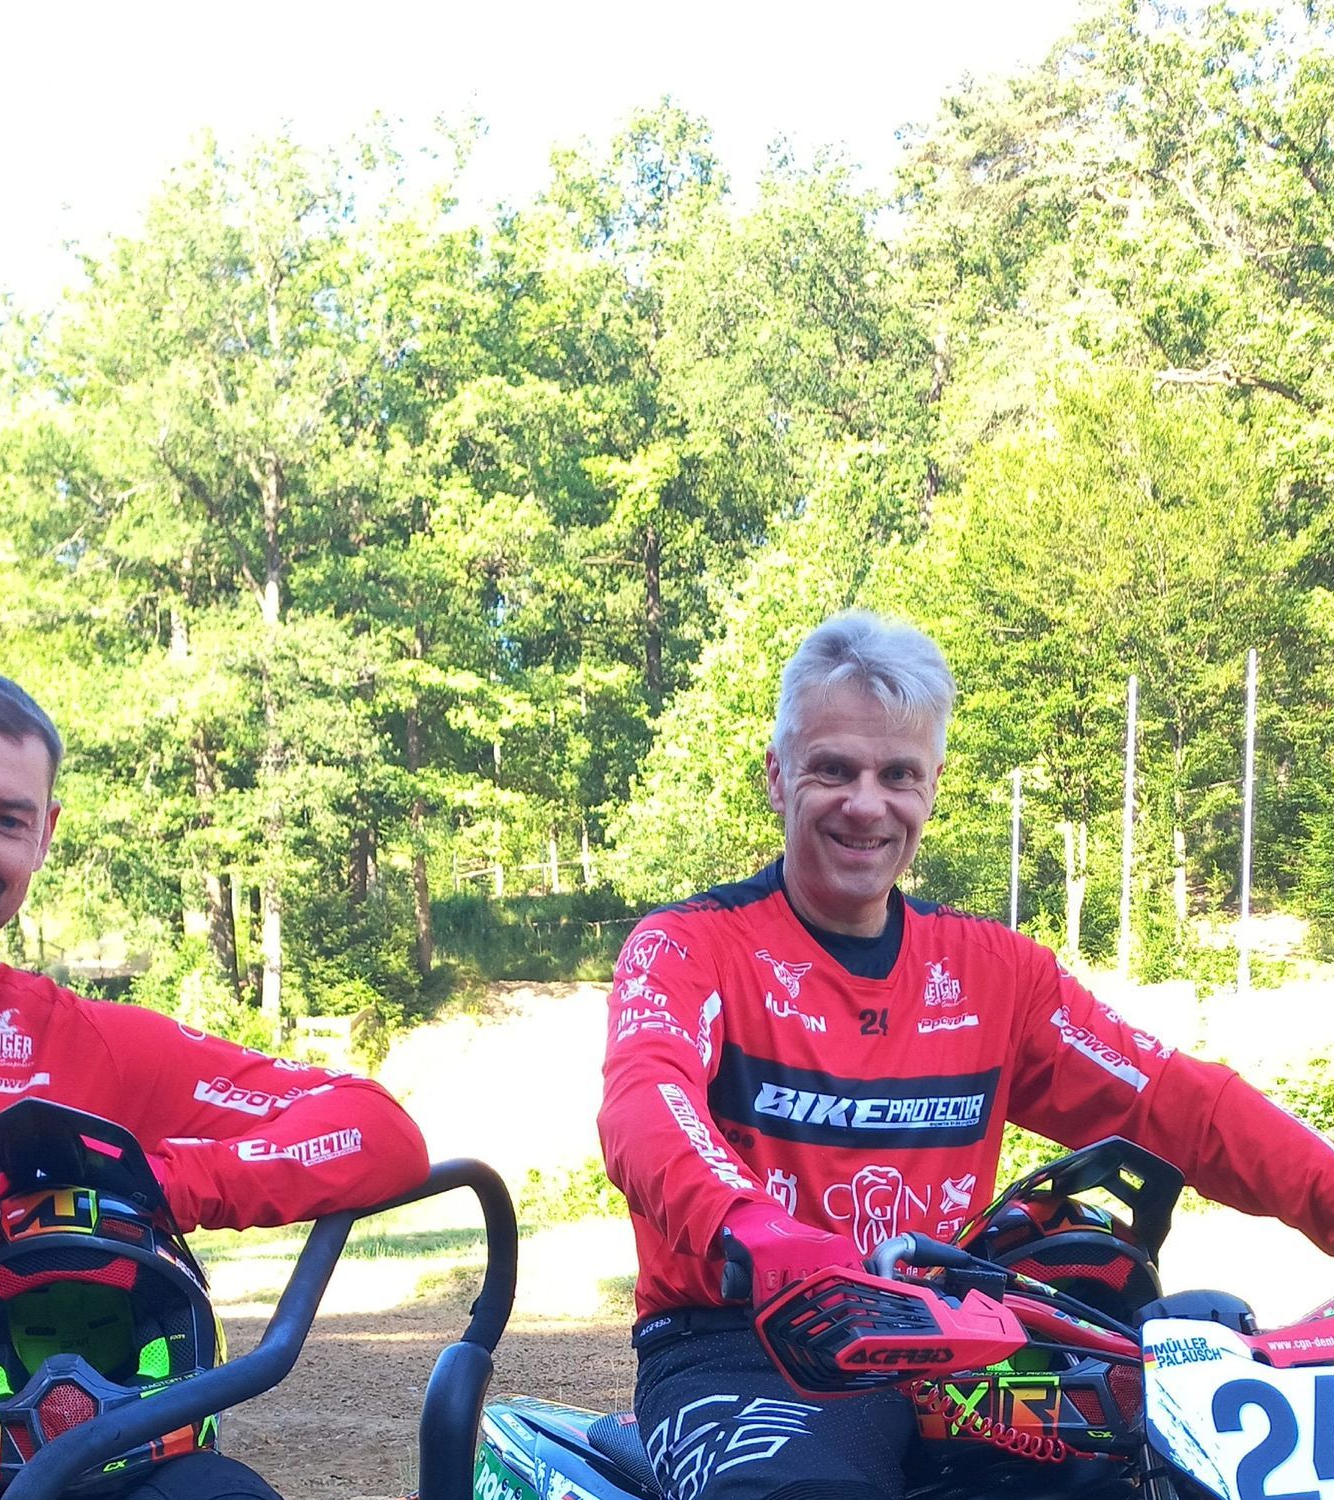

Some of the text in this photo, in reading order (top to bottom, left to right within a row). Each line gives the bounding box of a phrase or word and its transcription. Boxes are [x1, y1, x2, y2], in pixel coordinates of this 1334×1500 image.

[936, 1216, 965, 1234] FT
[1153, 1336, 1208, 1356] MÜLLER
[1157, 1348, 1223, 1370] PALAUSCH
[103, 1458, 128, 1473] CX
